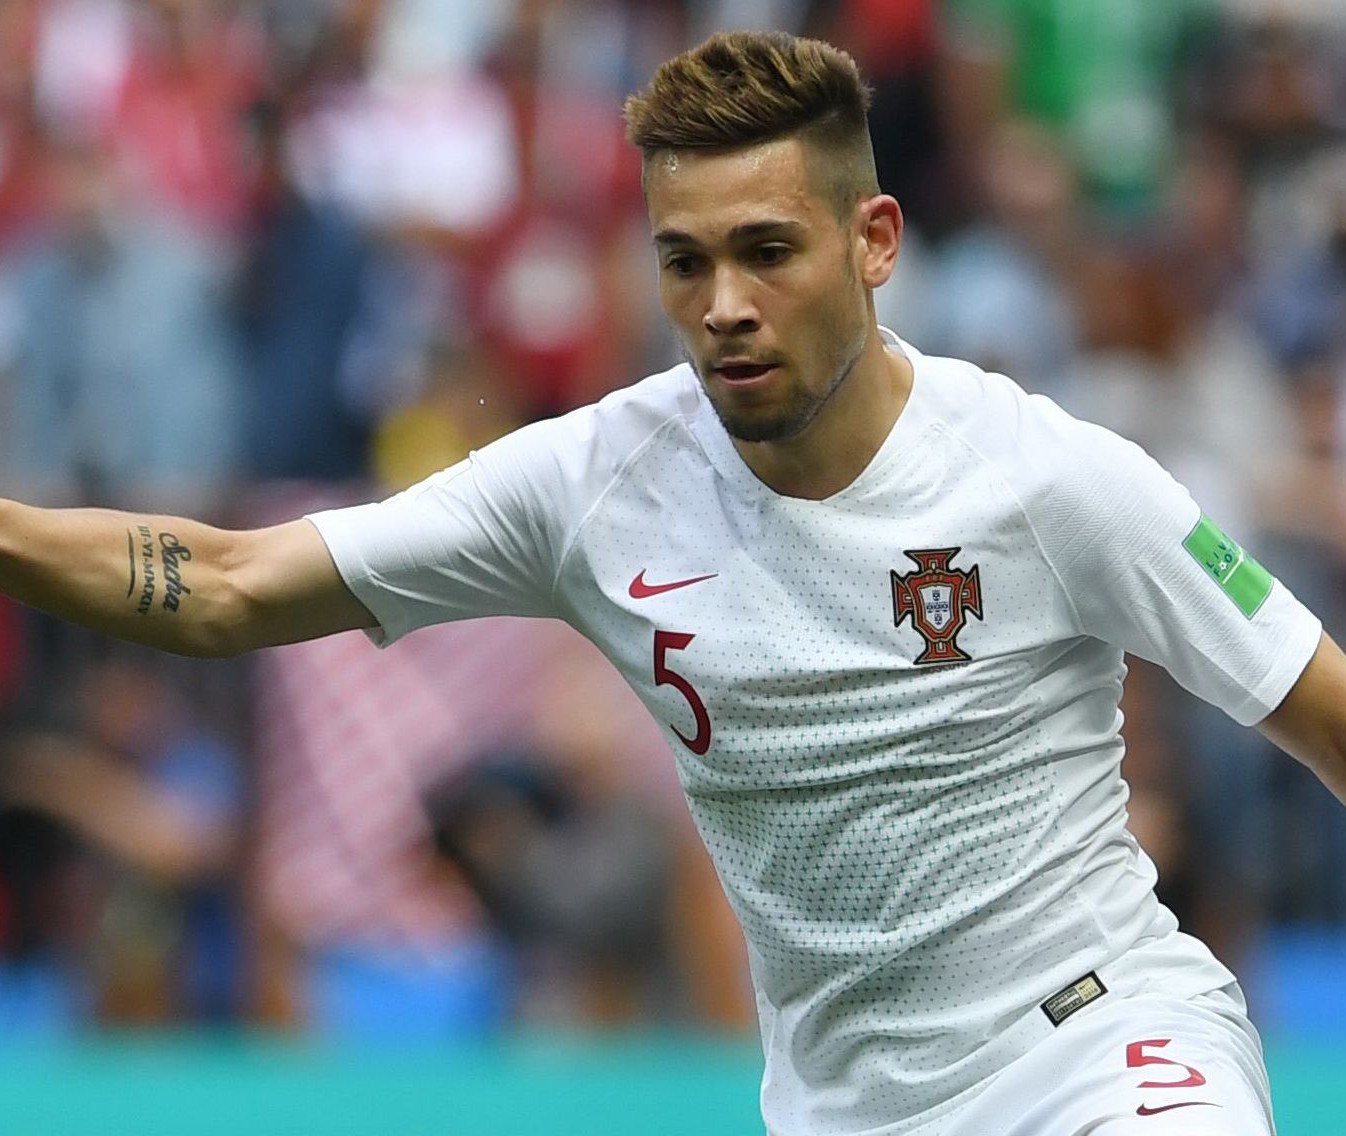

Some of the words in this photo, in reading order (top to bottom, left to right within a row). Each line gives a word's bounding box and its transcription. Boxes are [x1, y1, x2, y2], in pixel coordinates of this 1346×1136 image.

[158, 532, 192, 613] Sacha
[653, 629, 712, 756] 5
[1125, 1038, 1207, 1089] 5
